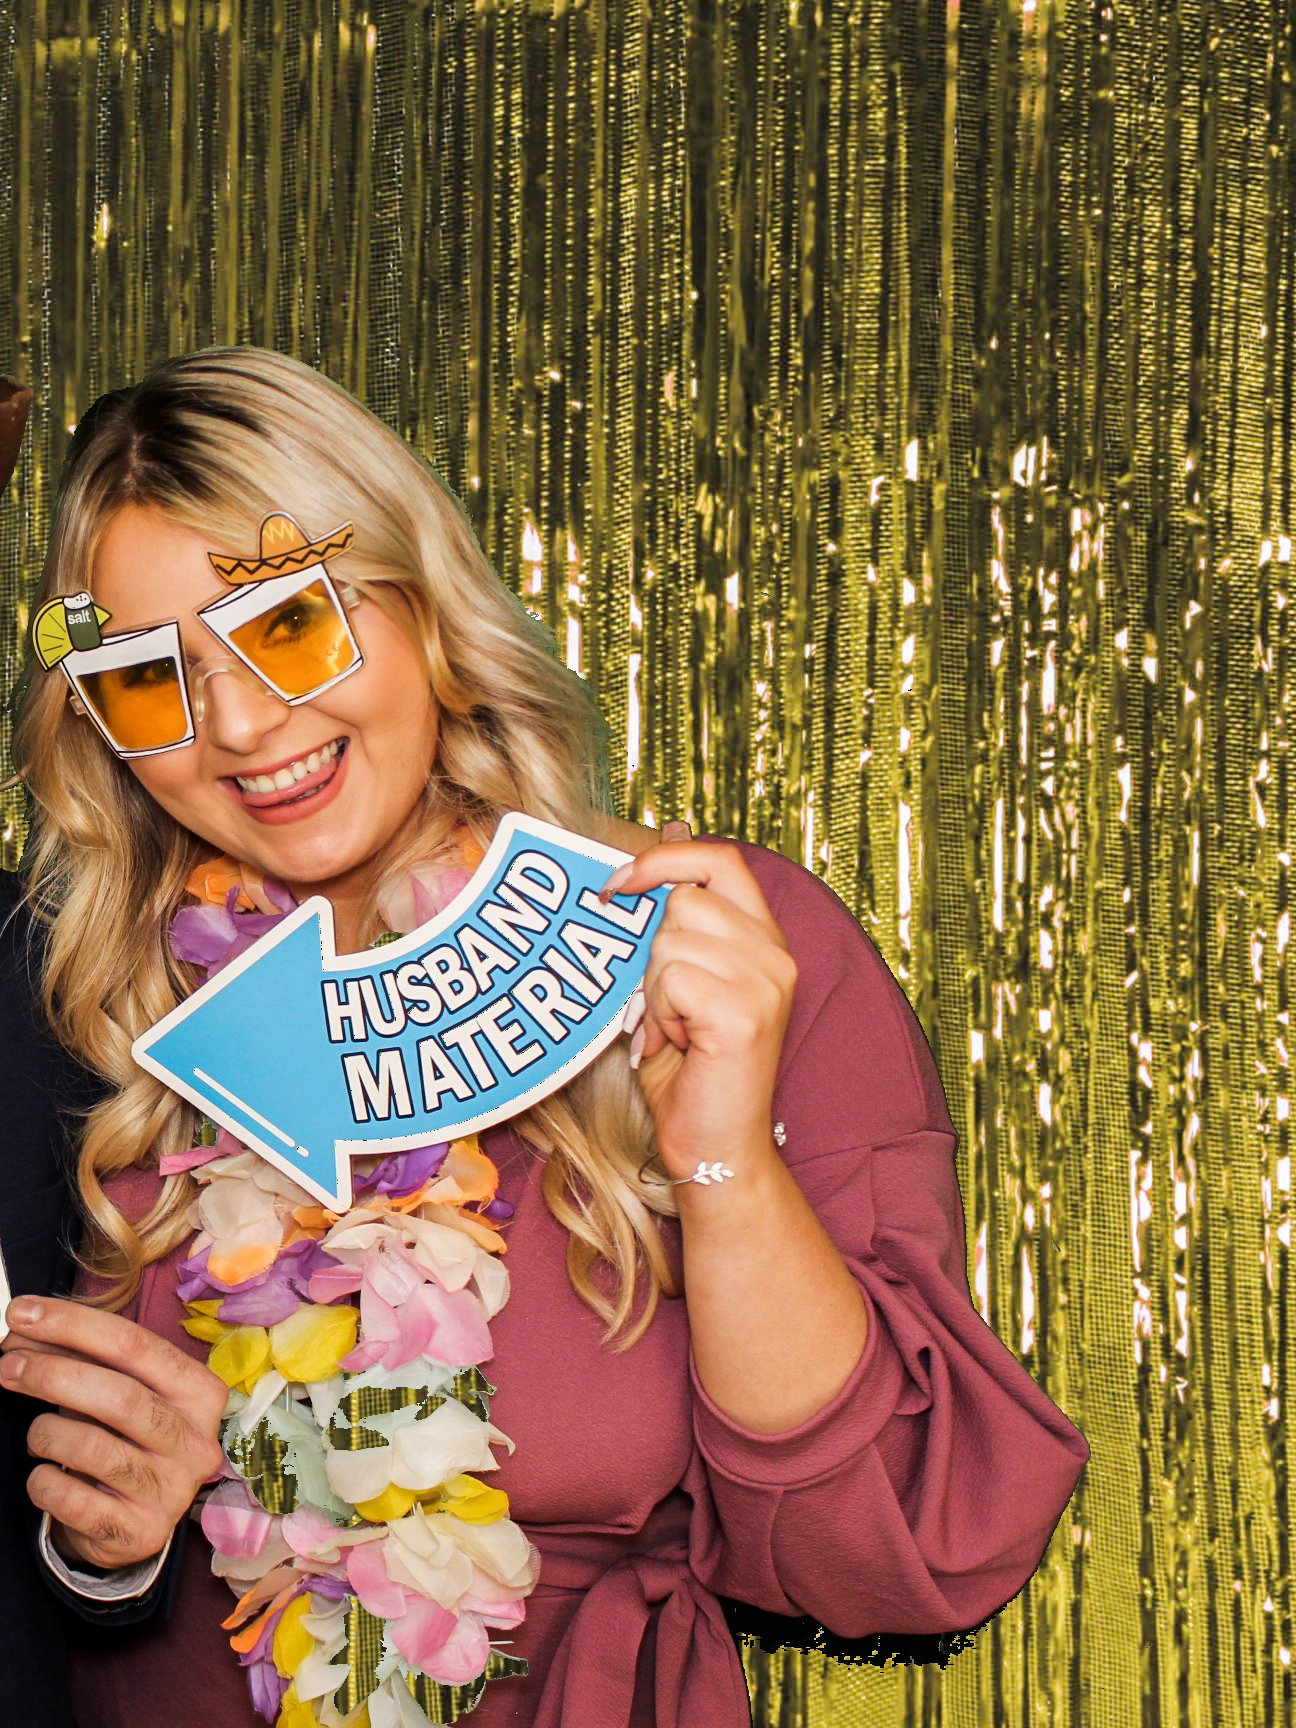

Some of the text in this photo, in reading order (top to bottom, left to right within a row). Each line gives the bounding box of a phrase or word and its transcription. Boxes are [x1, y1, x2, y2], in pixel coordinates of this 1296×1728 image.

[67, 610, 91, 625] salt
[321, 848, 570, 1043] HUSBAND
[341, 887, 659, 1123] MATERIAL
